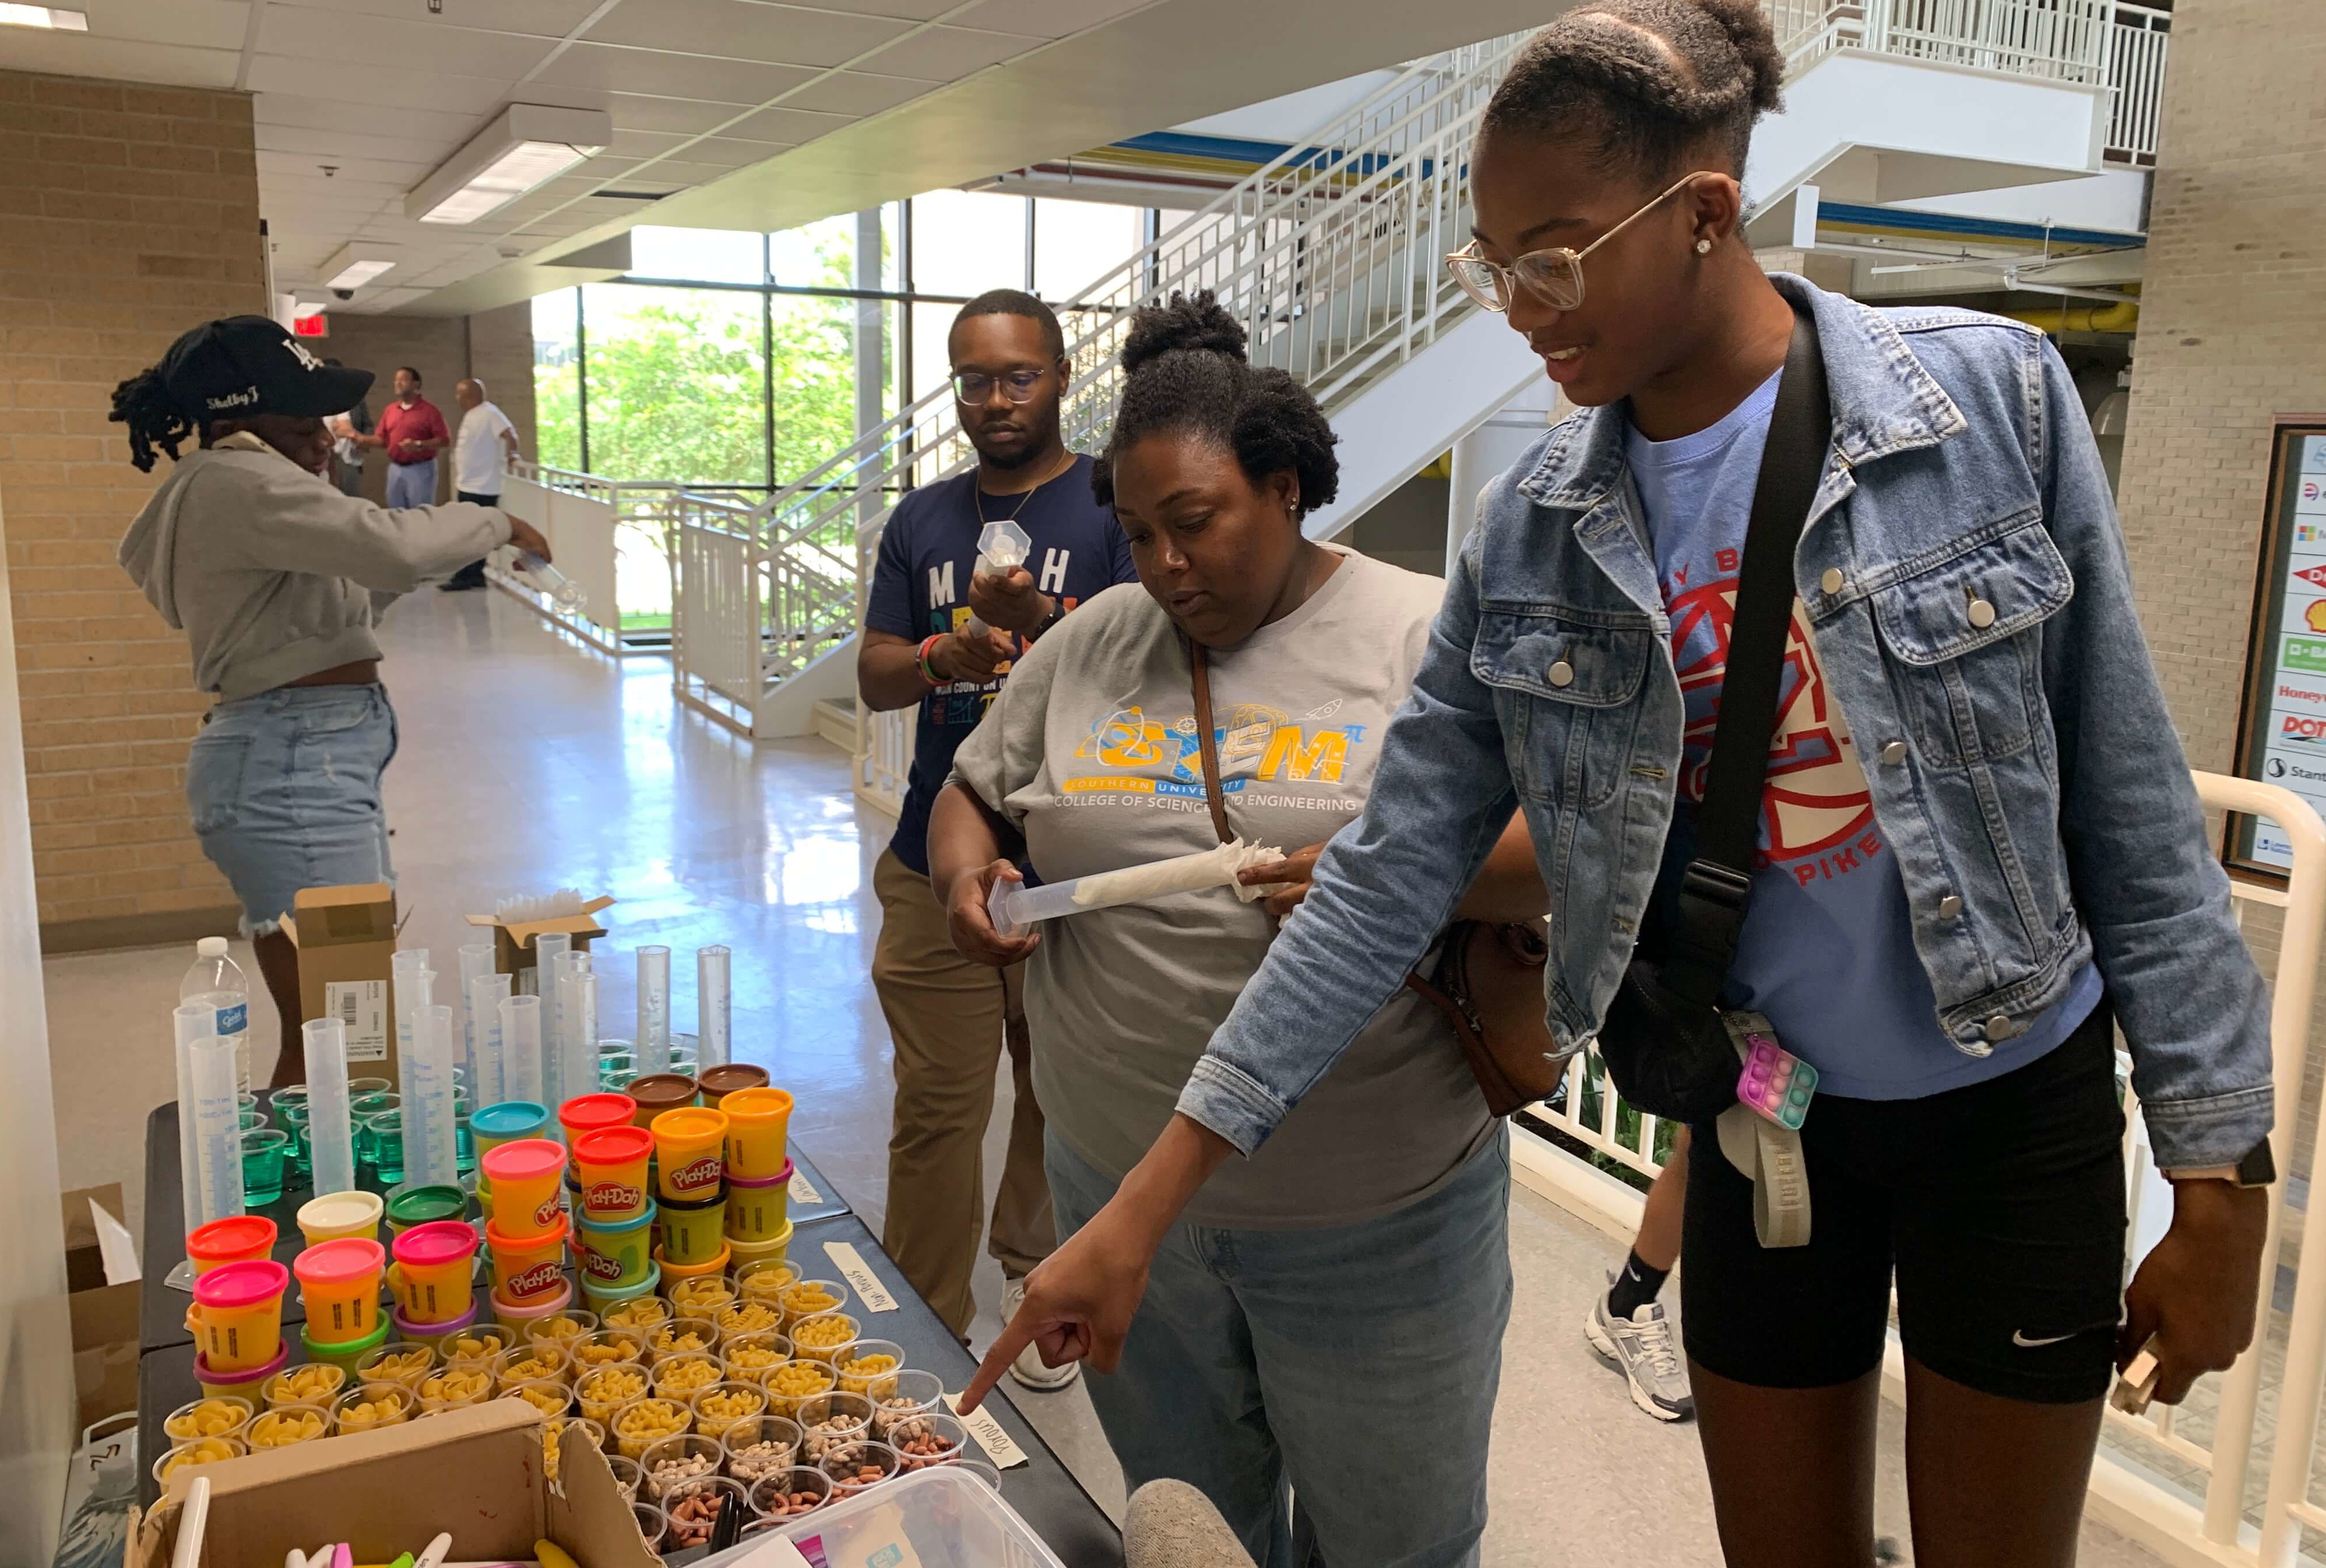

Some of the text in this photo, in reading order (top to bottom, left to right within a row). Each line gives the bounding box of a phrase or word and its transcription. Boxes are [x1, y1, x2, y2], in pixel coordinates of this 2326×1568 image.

[928, 547, 1070, 611] MH
[1071, 779, 1241, 796] SOUTHERN UNIVEITY
[1054, 795, 1116, 807] COLLEGE
[1121, 796, 1143, 807] OF
[1247, 794, 1356, 811] ENGINEERING
[584, 1187, 639, 1208] Play-Doh
[970, 1419, 1010, 1455] Porous
